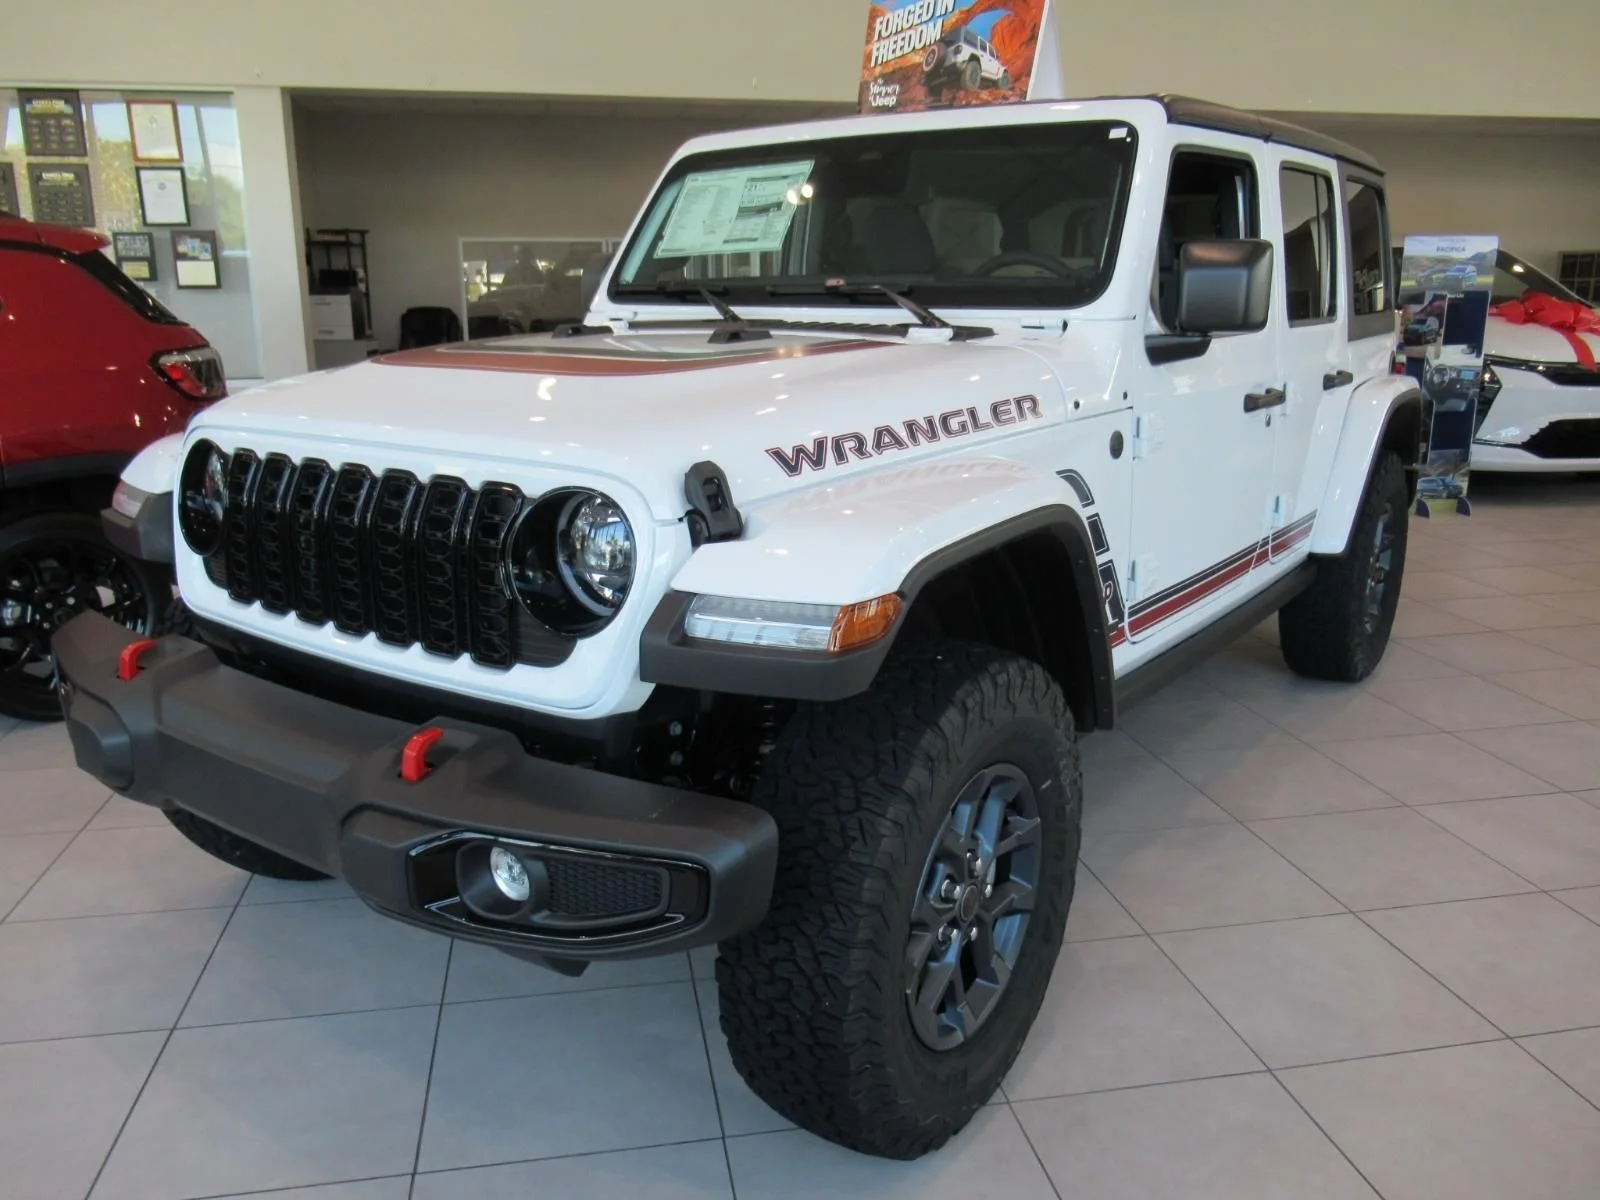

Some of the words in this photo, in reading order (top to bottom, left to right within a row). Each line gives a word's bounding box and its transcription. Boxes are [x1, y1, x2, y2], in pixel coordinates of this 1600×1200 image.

[871, 18, 944, 68] FREEDOM
[875, 0, 935, 41] FORGED
[936, 0, 955, 18] IN
[872, 95, 897, 108] Jeep
[765, 394, 1043, 477] WRANGLER
